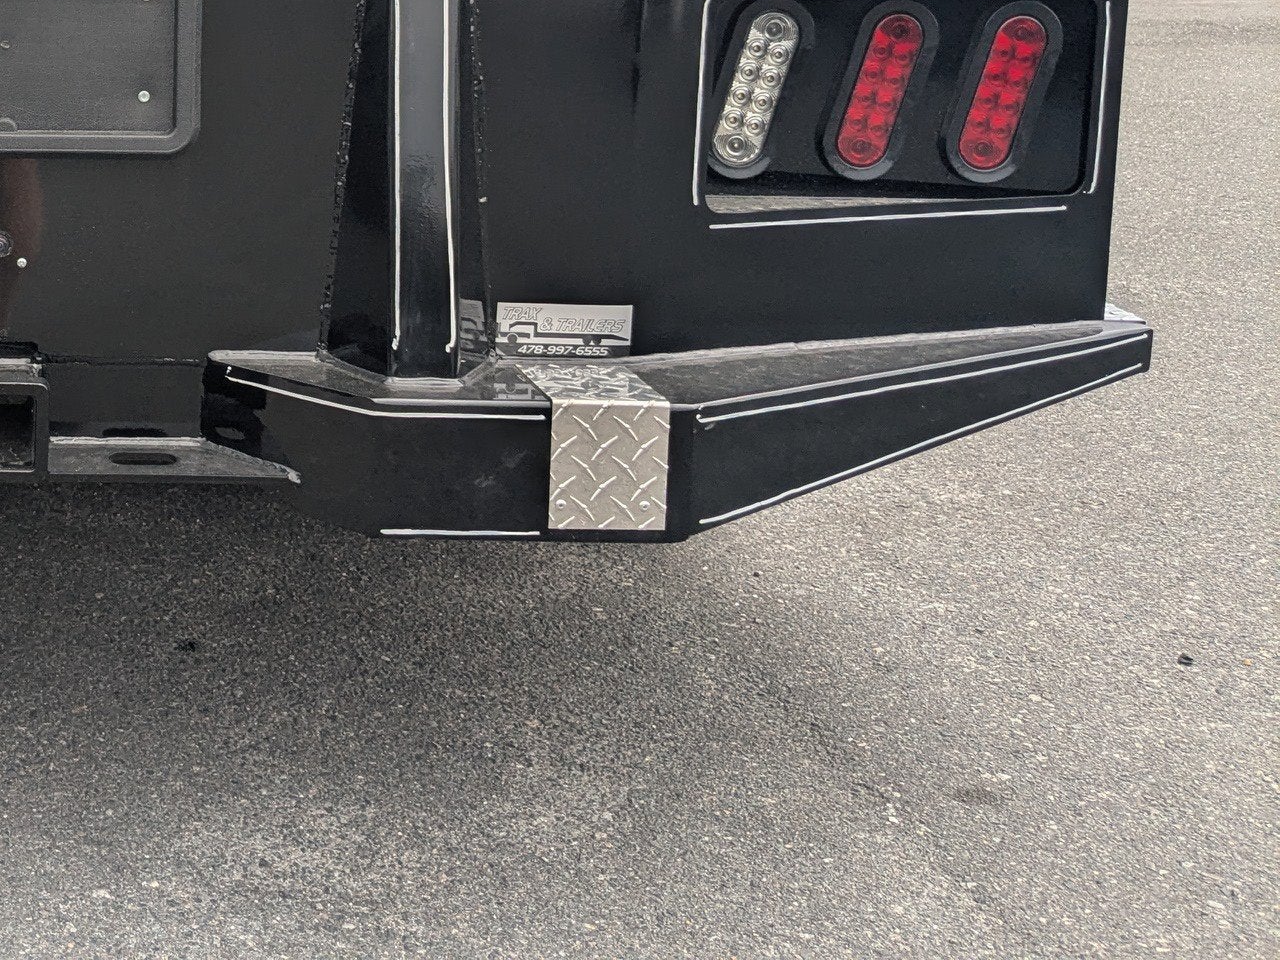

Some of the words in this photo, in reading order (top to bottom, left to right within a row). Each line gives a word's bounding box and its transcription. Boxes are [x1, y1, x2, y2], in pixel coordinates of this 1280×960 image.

[502, 306, 544, 320] TRAX
[539, 317, 554, 332] &
[555, 317, 627, 332] TRAILERS
[517, 344, 610, 356] 478-997-6555
